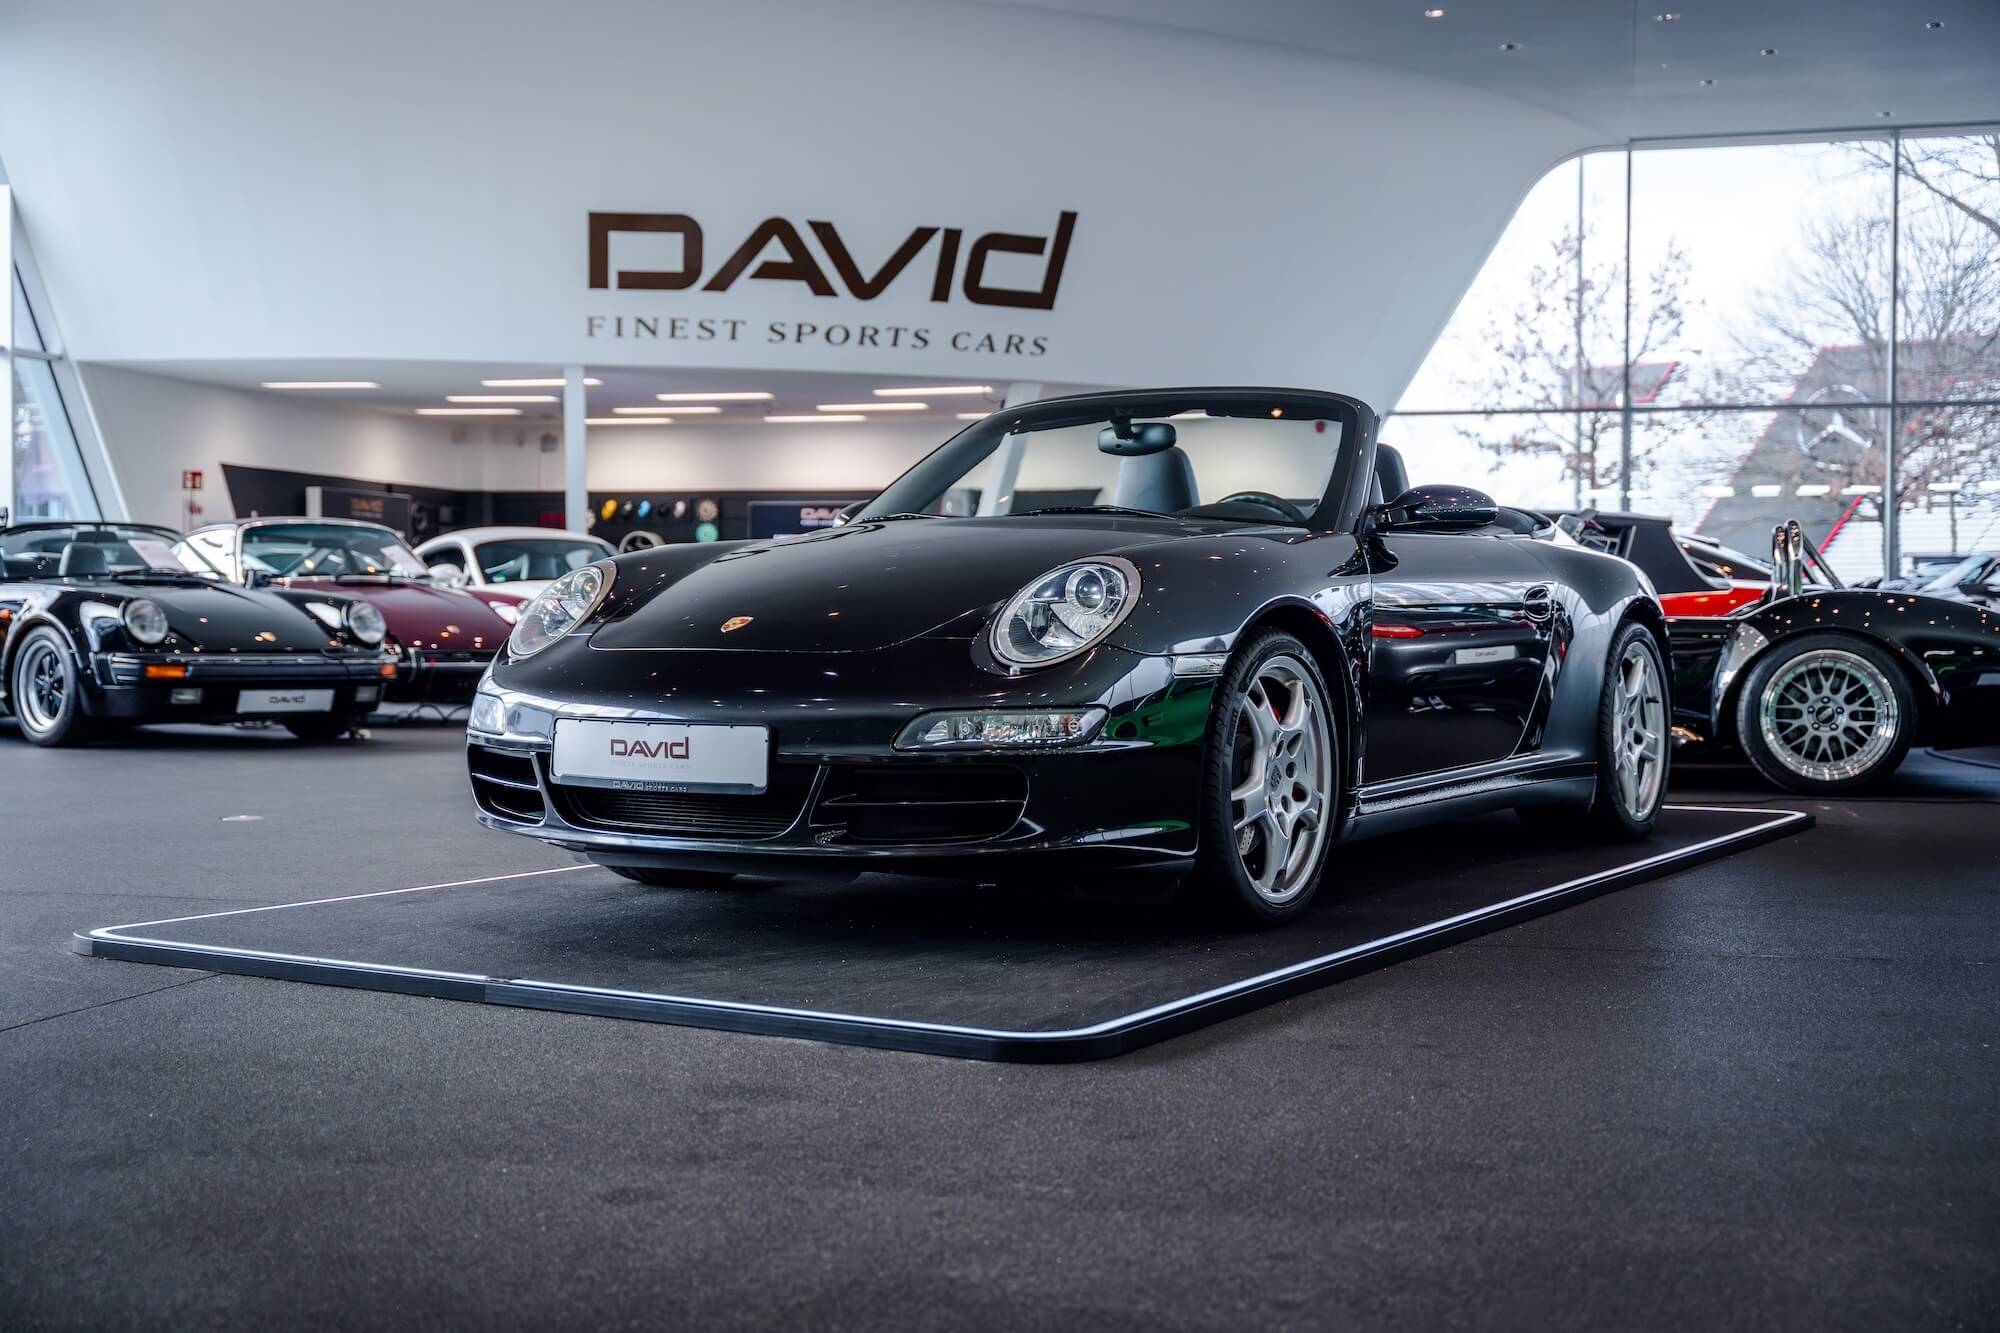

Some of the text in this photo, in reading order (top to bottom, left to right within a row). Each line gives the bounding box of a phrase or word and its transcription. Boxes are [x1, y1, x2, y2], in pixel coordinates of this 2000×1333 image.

[586, 315, 1049, 357] FINEST SPORTS CARS
